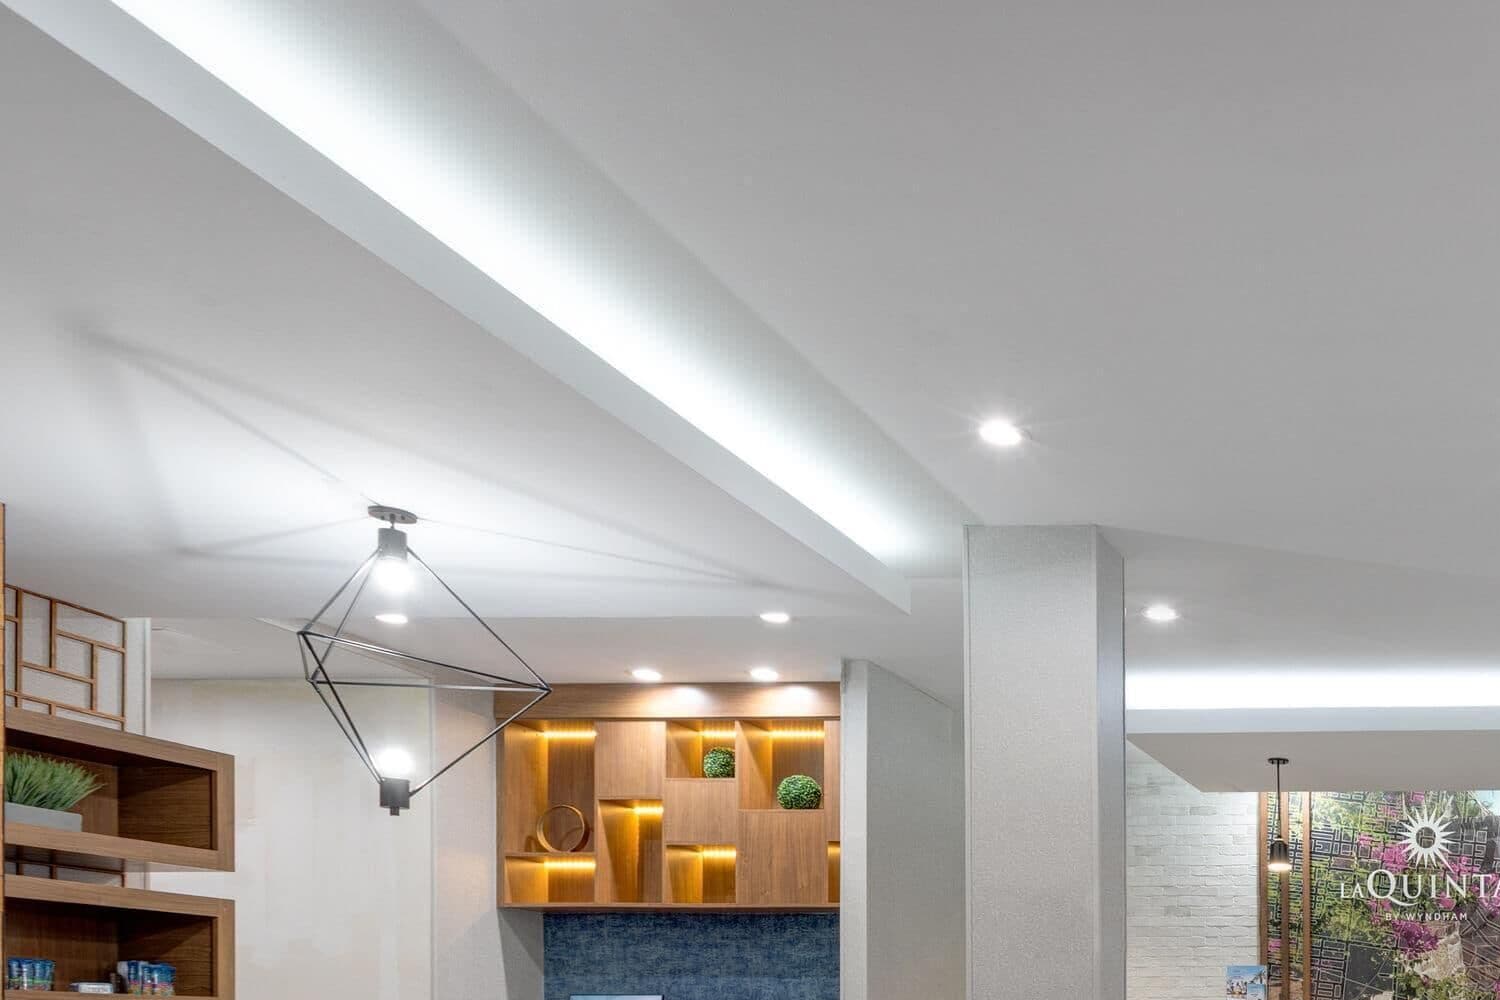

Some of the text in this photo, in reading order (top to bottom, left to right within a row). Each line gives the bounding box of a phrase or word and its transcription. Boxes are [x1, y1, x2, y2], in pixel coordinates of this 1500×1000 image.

[1340, 882, 1365, 899] LA
[1385, 913, 1468, 921] BY WYNDHAM
